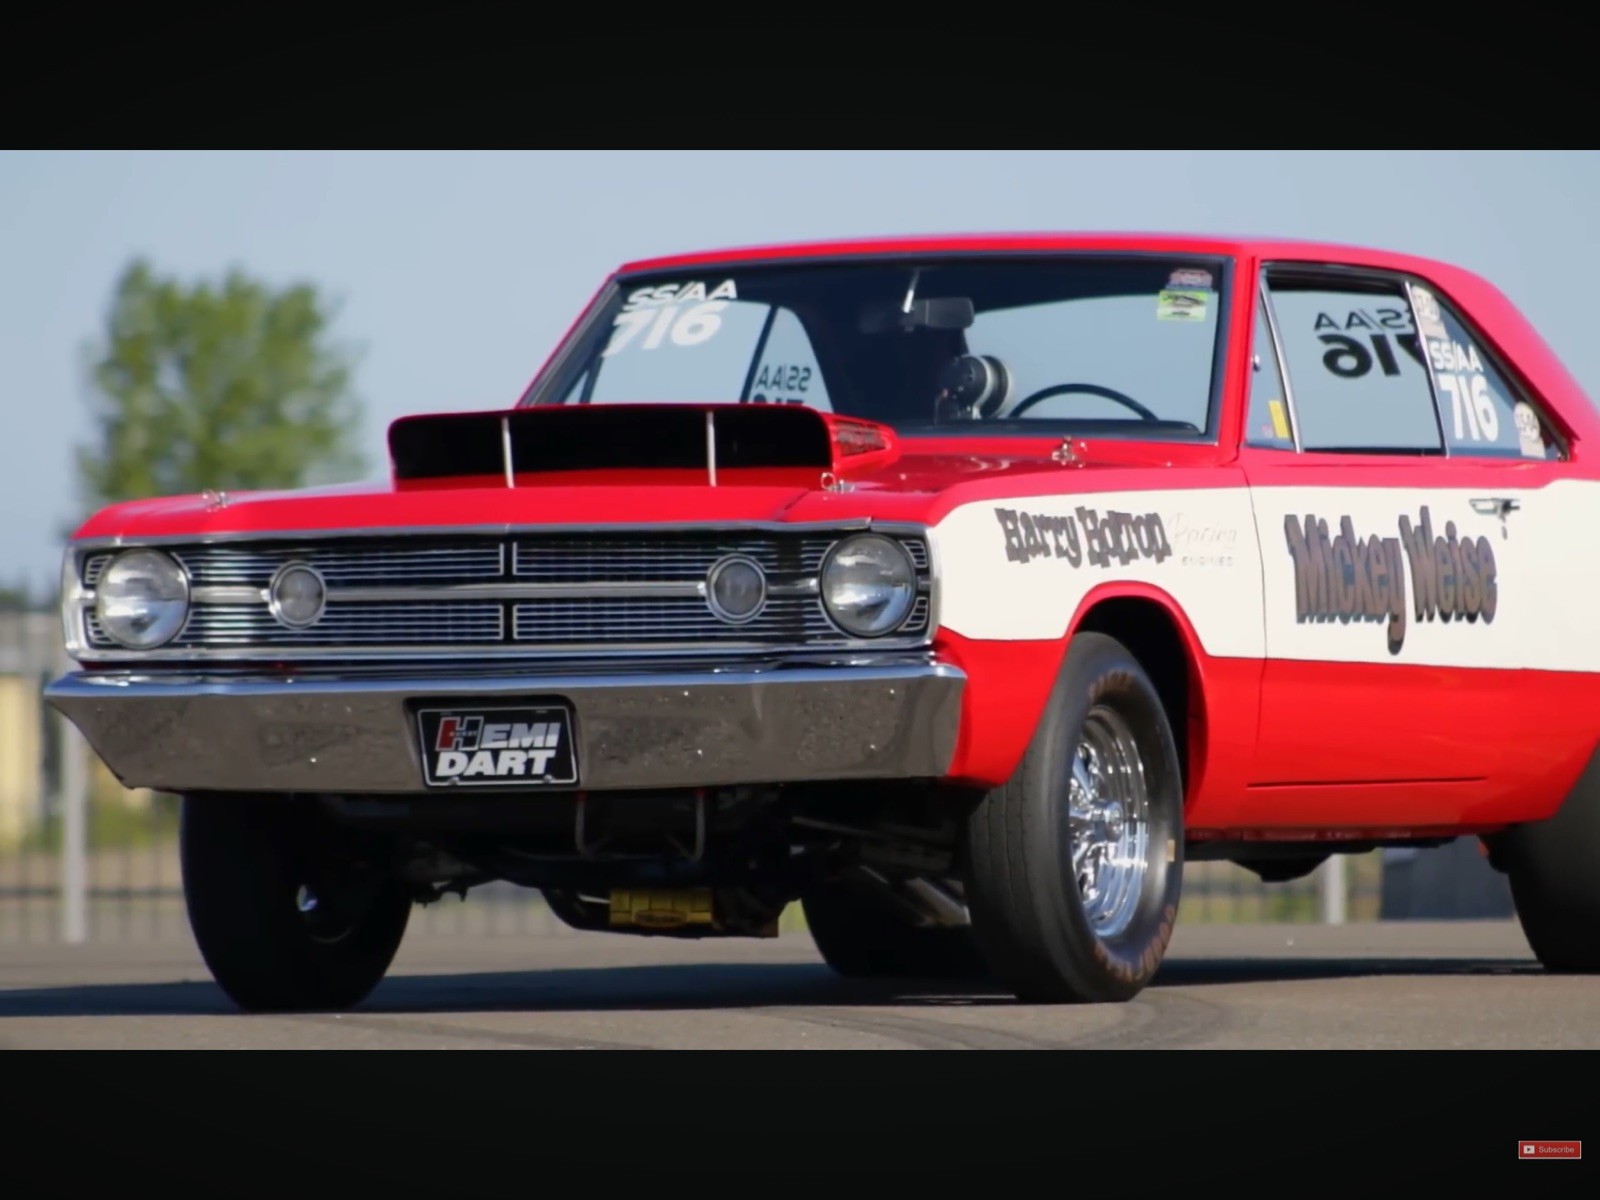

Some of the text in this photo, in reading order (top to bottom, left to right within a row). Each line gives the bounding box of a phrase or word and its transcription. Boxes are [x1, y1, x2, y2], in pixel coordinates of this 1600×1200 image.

[622, 279, 737, 311] SS/AA
[601, 301, 729, 358] 716
[1430, 340, 1484, 372] SS/AA
[1438, 375, 1499, 442] 716
[994, 508, 1082, 568] Harry
[1284, 505, 1497, 655] Mickey Weise
[435, 716, 561, 751] HEMI
[435, 750, 556, 777] DART
